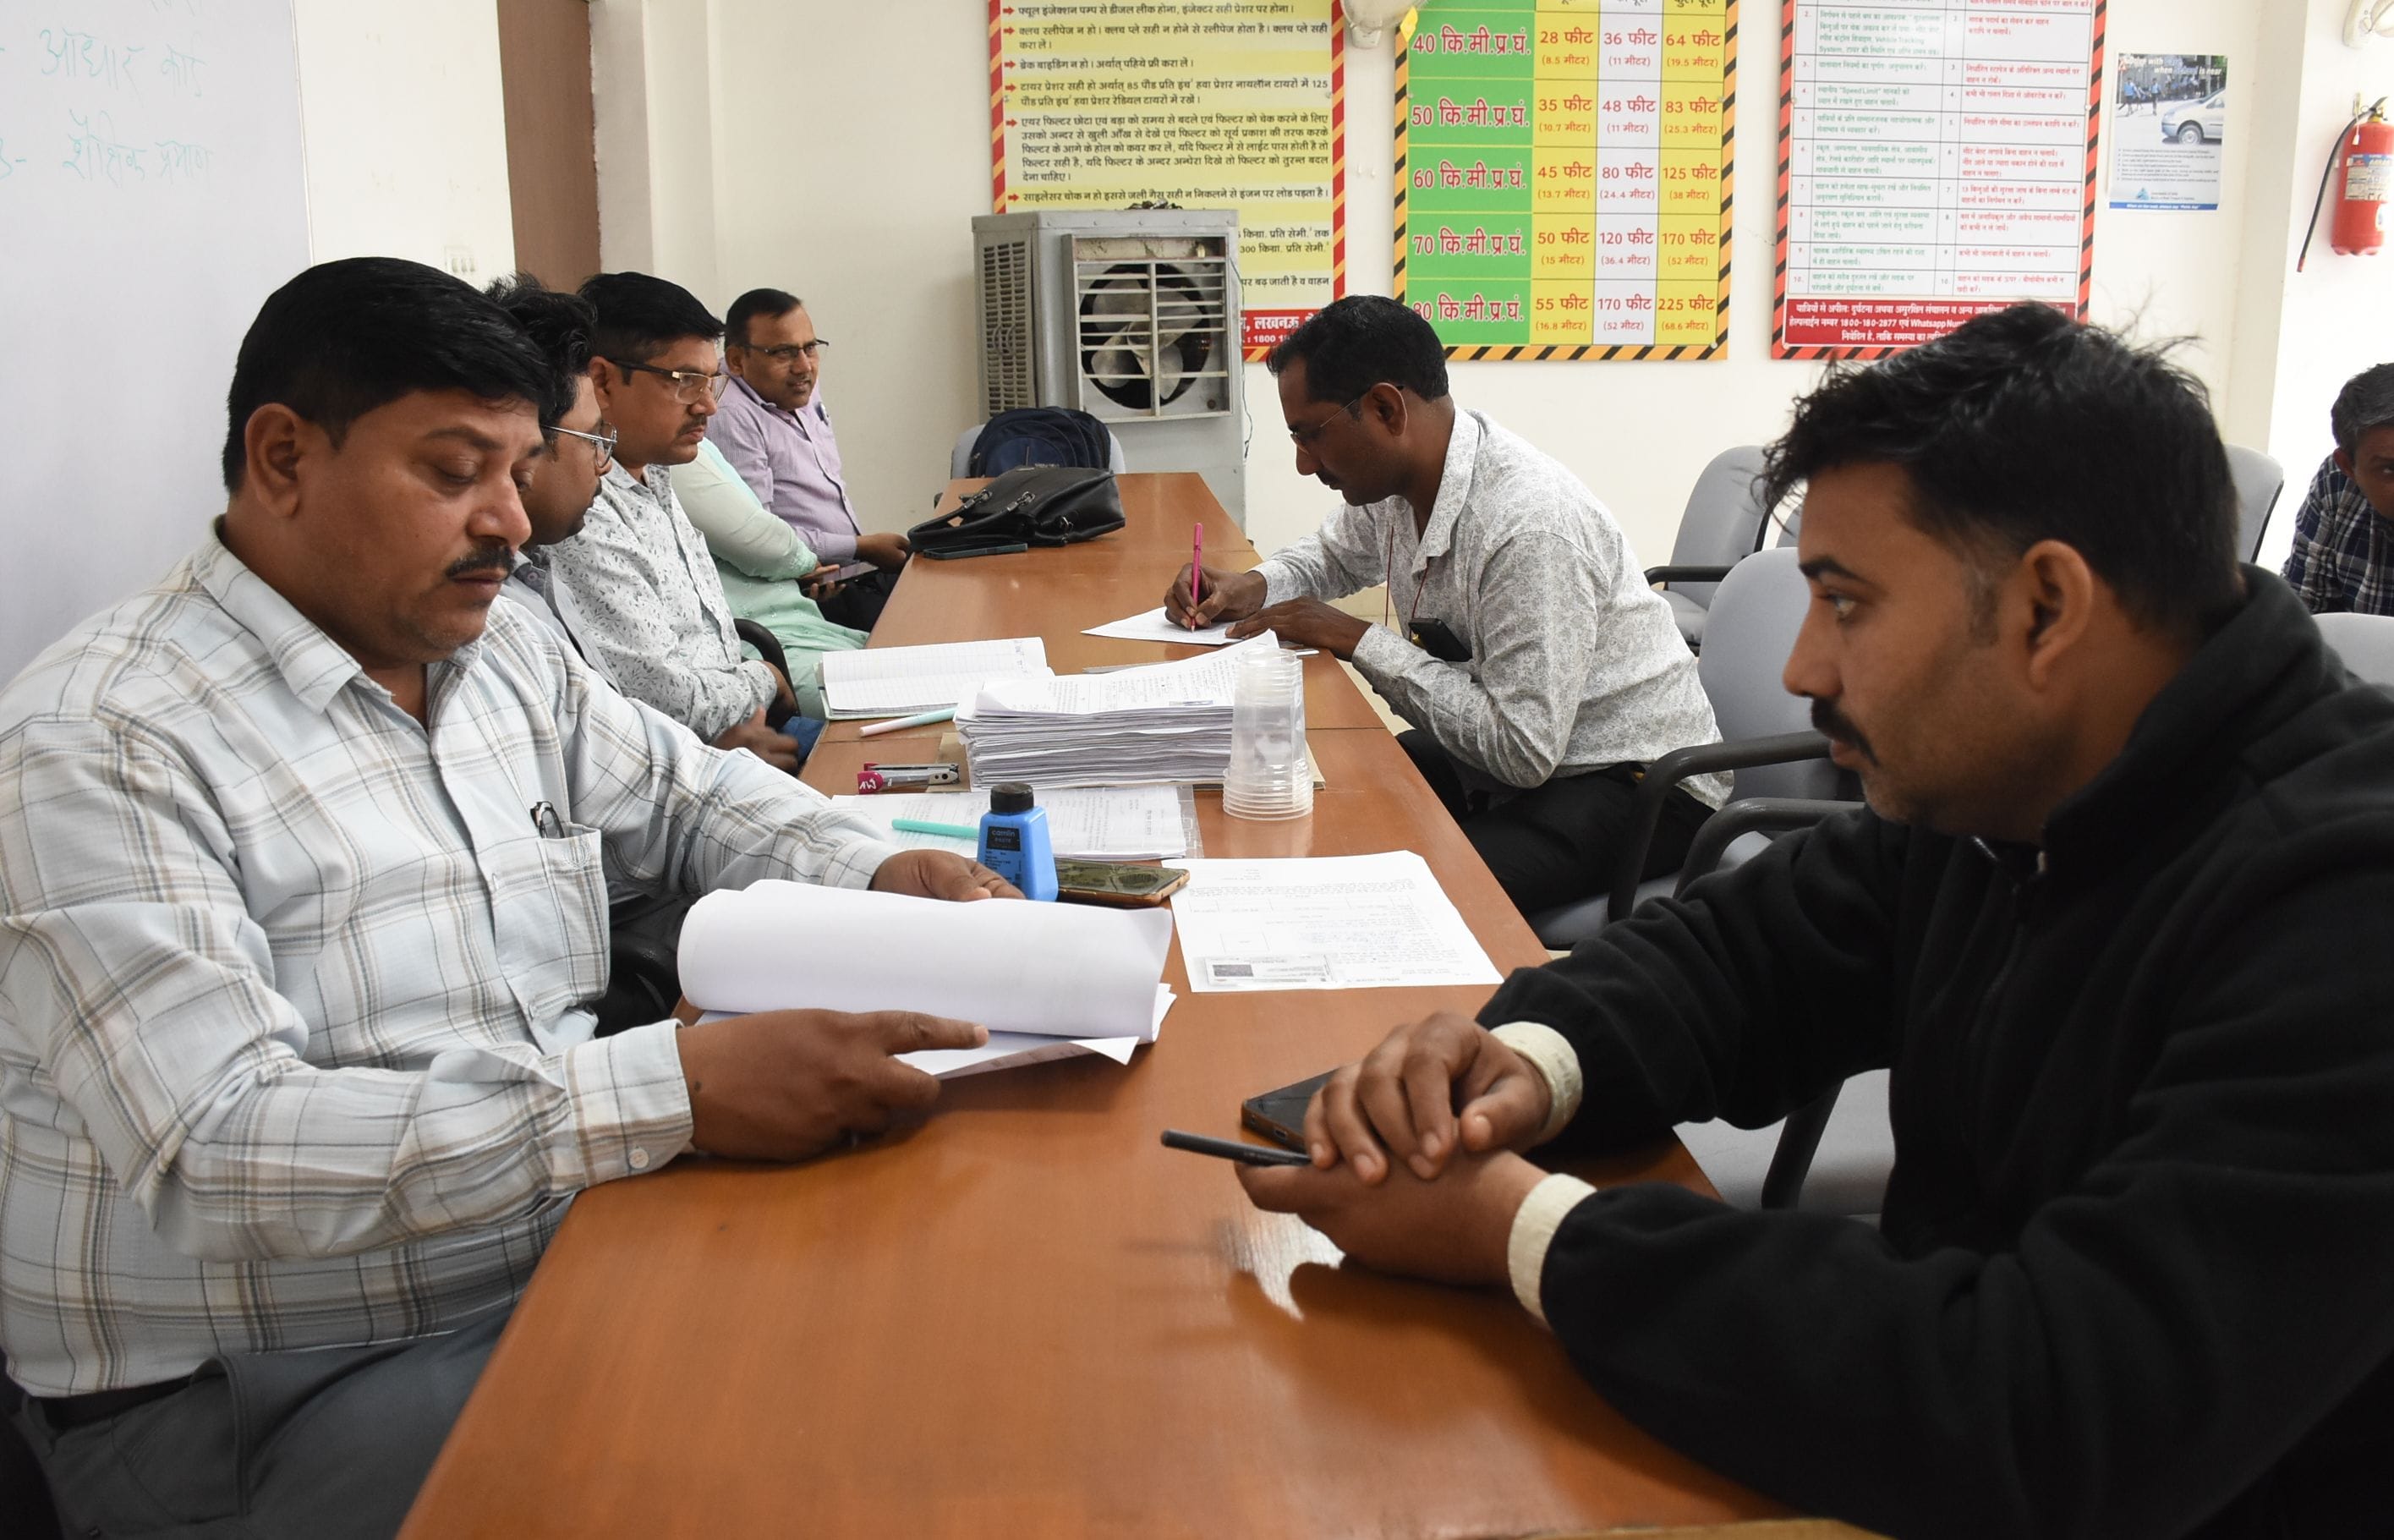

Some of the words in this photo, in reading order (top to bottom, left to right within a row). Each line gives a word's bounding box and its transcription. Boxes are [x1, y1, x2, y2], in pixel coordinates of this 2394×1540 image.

[1098, 3, 1108, 14] से
[1215, 3, 1232, 14] सही
[1255, 5, 1268, 14] पर
[1540, 31, 1559, 44] 28
[1564, 27, 1593, 44] फीट
[1604, 33, 1622, 45] 36
[1627, 28, 1657, 45] फीट
[1666, 34, 1686, 46] 64
[1691, 30, 1721, 47] फीट
[1413, 33, 1435, 53] 40
[1542, 56, 1560, 65] (8.5
[1563, 56, 1590, 66] मीटर)
[1608, 56, 1621, 66] (11
[1624, 56, 1651, 67] मीटर)
[1667, 58, 1689, 67] (19.5
[1692, 56, 1718, 68] मीटर)
[1539, 99, 1557, 112] 35
[1563, 94, 1592, 111] फीट
[1602, 101, 1621, 112] 48
[1626, 95, 1656, 112] फीट
[1665, 101, 1683, 113] 83
[1689, 96, 1719, 113] फीट
[1127, 113, 1139, 124] को
[1167, 112, 1175, 124] से
[1246, 112, 1257, 123] को
[1300, 112, 1309, 123] के
[1411, 105, 1433, 125] 50
[1539, 122, 1561, 132] (10.7
[1564, 122, 1591, 133] मीटर)
[1607, 123, 1619, 134] (11
[1623, 122, 1649, 134] मीटर)
[1664, 124, 1688, 134] (25.3
[1691, 123, 1717, 135] मीटर)
[1537, 167, 1557, 178] 45
[1563, 162, 1592, 178] फीट
[1602, 167, 1619, 178] 80
[1624, 162, 1654, 179] फीट
[1663, 167, 1686, 179] 125
[1691, 163, 1717, 179] फीट
[1413, 168, 1433, 189] 60
[1083, 192, 1091, 200] न
[1093, 189, 1102, 200] हो
[1166, 188, 1183, 200] सही
[1185, 190, 1192, 199] न
[1229, 187, 1237, 199] से
[1263, 189, 1274, 198] पर
[1538, 189, 1560, 200] (13.7
[1564, 189, 1590, 200] मीटर)
[1600, 189, 1626, 200] (24.4
[1629, 189, 1655, 200] मीटर)
[1669, 190, 1683, 200] (38
[1685, 189, 1710, 200] मीटर)
[1538, 233, 1555, 244] 50
[1560, 227, 1590, 244] फीट
[1600, 233, 1622, 244] 120
[1627, 227, 1654, 244] फीट
[1663, 233, 1685, 244] 170
[1690, 228, 1716, 244] फीट
[1412, 235, 1433, 255] 70
[1542, 255, 1555, 265] (15
[1559, 255, 1585, 265] मीटर)
[1601, 255, 1624, 266] (36.4
[1627, 255, 1650, 266] मीटर)
[1668, 256, 1682, 266] (52
[1685, 255, 1708, 266] मीटर)
[1536, 299, 1553, 310] 55
[1559, 293, 1589, 310] फीट
[1597, 299, 1620, 310] 170
[1625, 293, 1652, 310] फीट
[1657, 299, 1684, 310] 225
[1689, 293, 1715, 310] फीट
[1536, 321, 1558, 332] (16.8
[1560, 320, 1586, 331] मीटर)
[1603, 321, 1618, 332] (52
[1620, 320, 1644, 332] मीटर)
[1662, 321, 1686, 332] (68.6
[1687, 320, 1708, 332] मीटर)
[1911, 319, 1946, 328] Whatsapp
